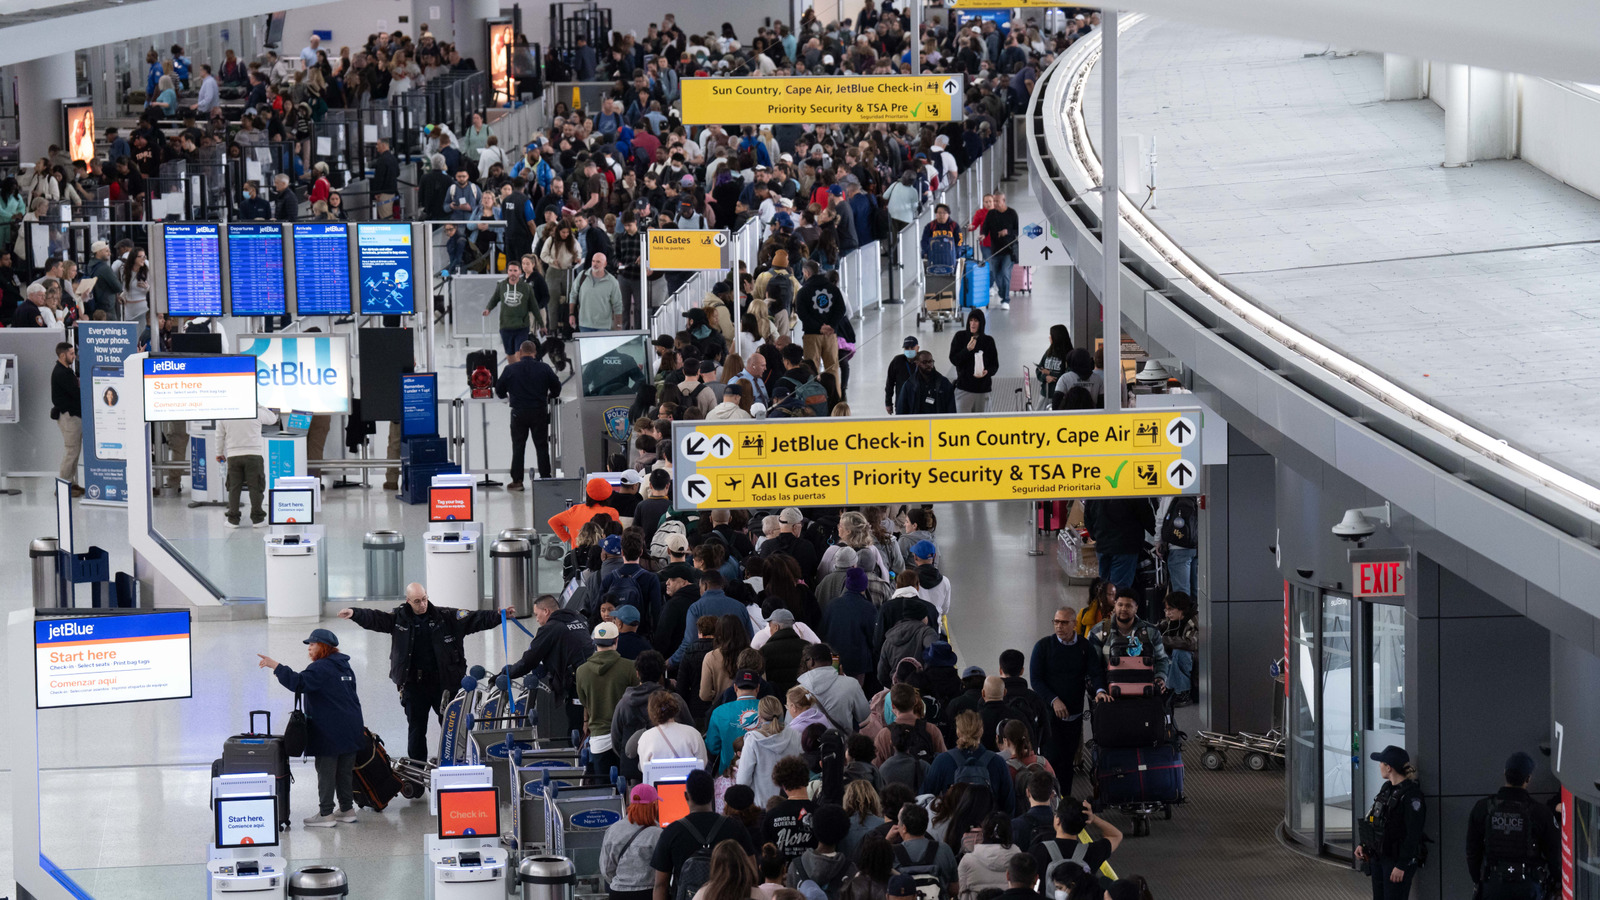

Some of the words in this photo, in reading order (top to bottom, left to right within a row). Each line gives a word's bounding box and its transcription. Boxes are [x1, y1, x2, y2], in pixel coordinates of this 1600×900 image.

[712, 86, 732, 95] Sun
[736, 85, 781, 96] Country,
[786, 84, 812, 95] Cape
[814, 84, 832, 95] Air,
[836, 84, 874, 94] JetBlue
[877, 83, 922, 93] Check-in
[768, 104, 806, 115] Priority
[810, 104, 852, 115] Security
[856, 104, 863, 113] &
[867, 103, 888, 112] TSA
[891, 103, 908, 112] Pre
[666, 236, 690, 244] Gates
[88, 328, 121, 336] Everything
[153, 361, 186, 373] jetBlue
[256, 362, 337, 386] etBlue
[154, 381, 178, 390] Start
[181, 381, 202, 389] here
[771, 436, 838, 452] JetBlue
[845, 432, 924, 450] Check-in
[938, 432, 970, 448] Sun
[976, 430, 1050, 448] Country,
[1056, 427, 1099, 446] Cape
[1105, 426, 1131, 442] Air
[751, 472, 777, 489] All
[785, 472, 840, 488] Gates
[853, 469, 921, 488] Priority
[928, 466, 1003, 486] Security
[1010, 465, 1023, 480] &
[1029, 464, 1066, 480] TSA
[1072, 463, 1100, 479] Pre
[1012, 484, 1056, 494] Seguridad
[1058, 483, 1100, 492] Prioritaria
[752, 493, 776, 502] Todas
[779, 493, 791, 501] las
[793, 493, 826, 502] puertas
[1360, 563, 1400, 594] EXIT
[48, 622, 94, 640] jetBlue
[50, 651, 84, 663] Start
[87, 650, 117, 661] here
[50, 680, 96, 688] Comenzar
[98, 676, 117, 686] aquí
[445, 711, 456, 760] smartecarte
[1555, 721, 1563, 772] 7
[450, 811, 477, 819] Check
[1492, 816, 1523, 827] POLICE
